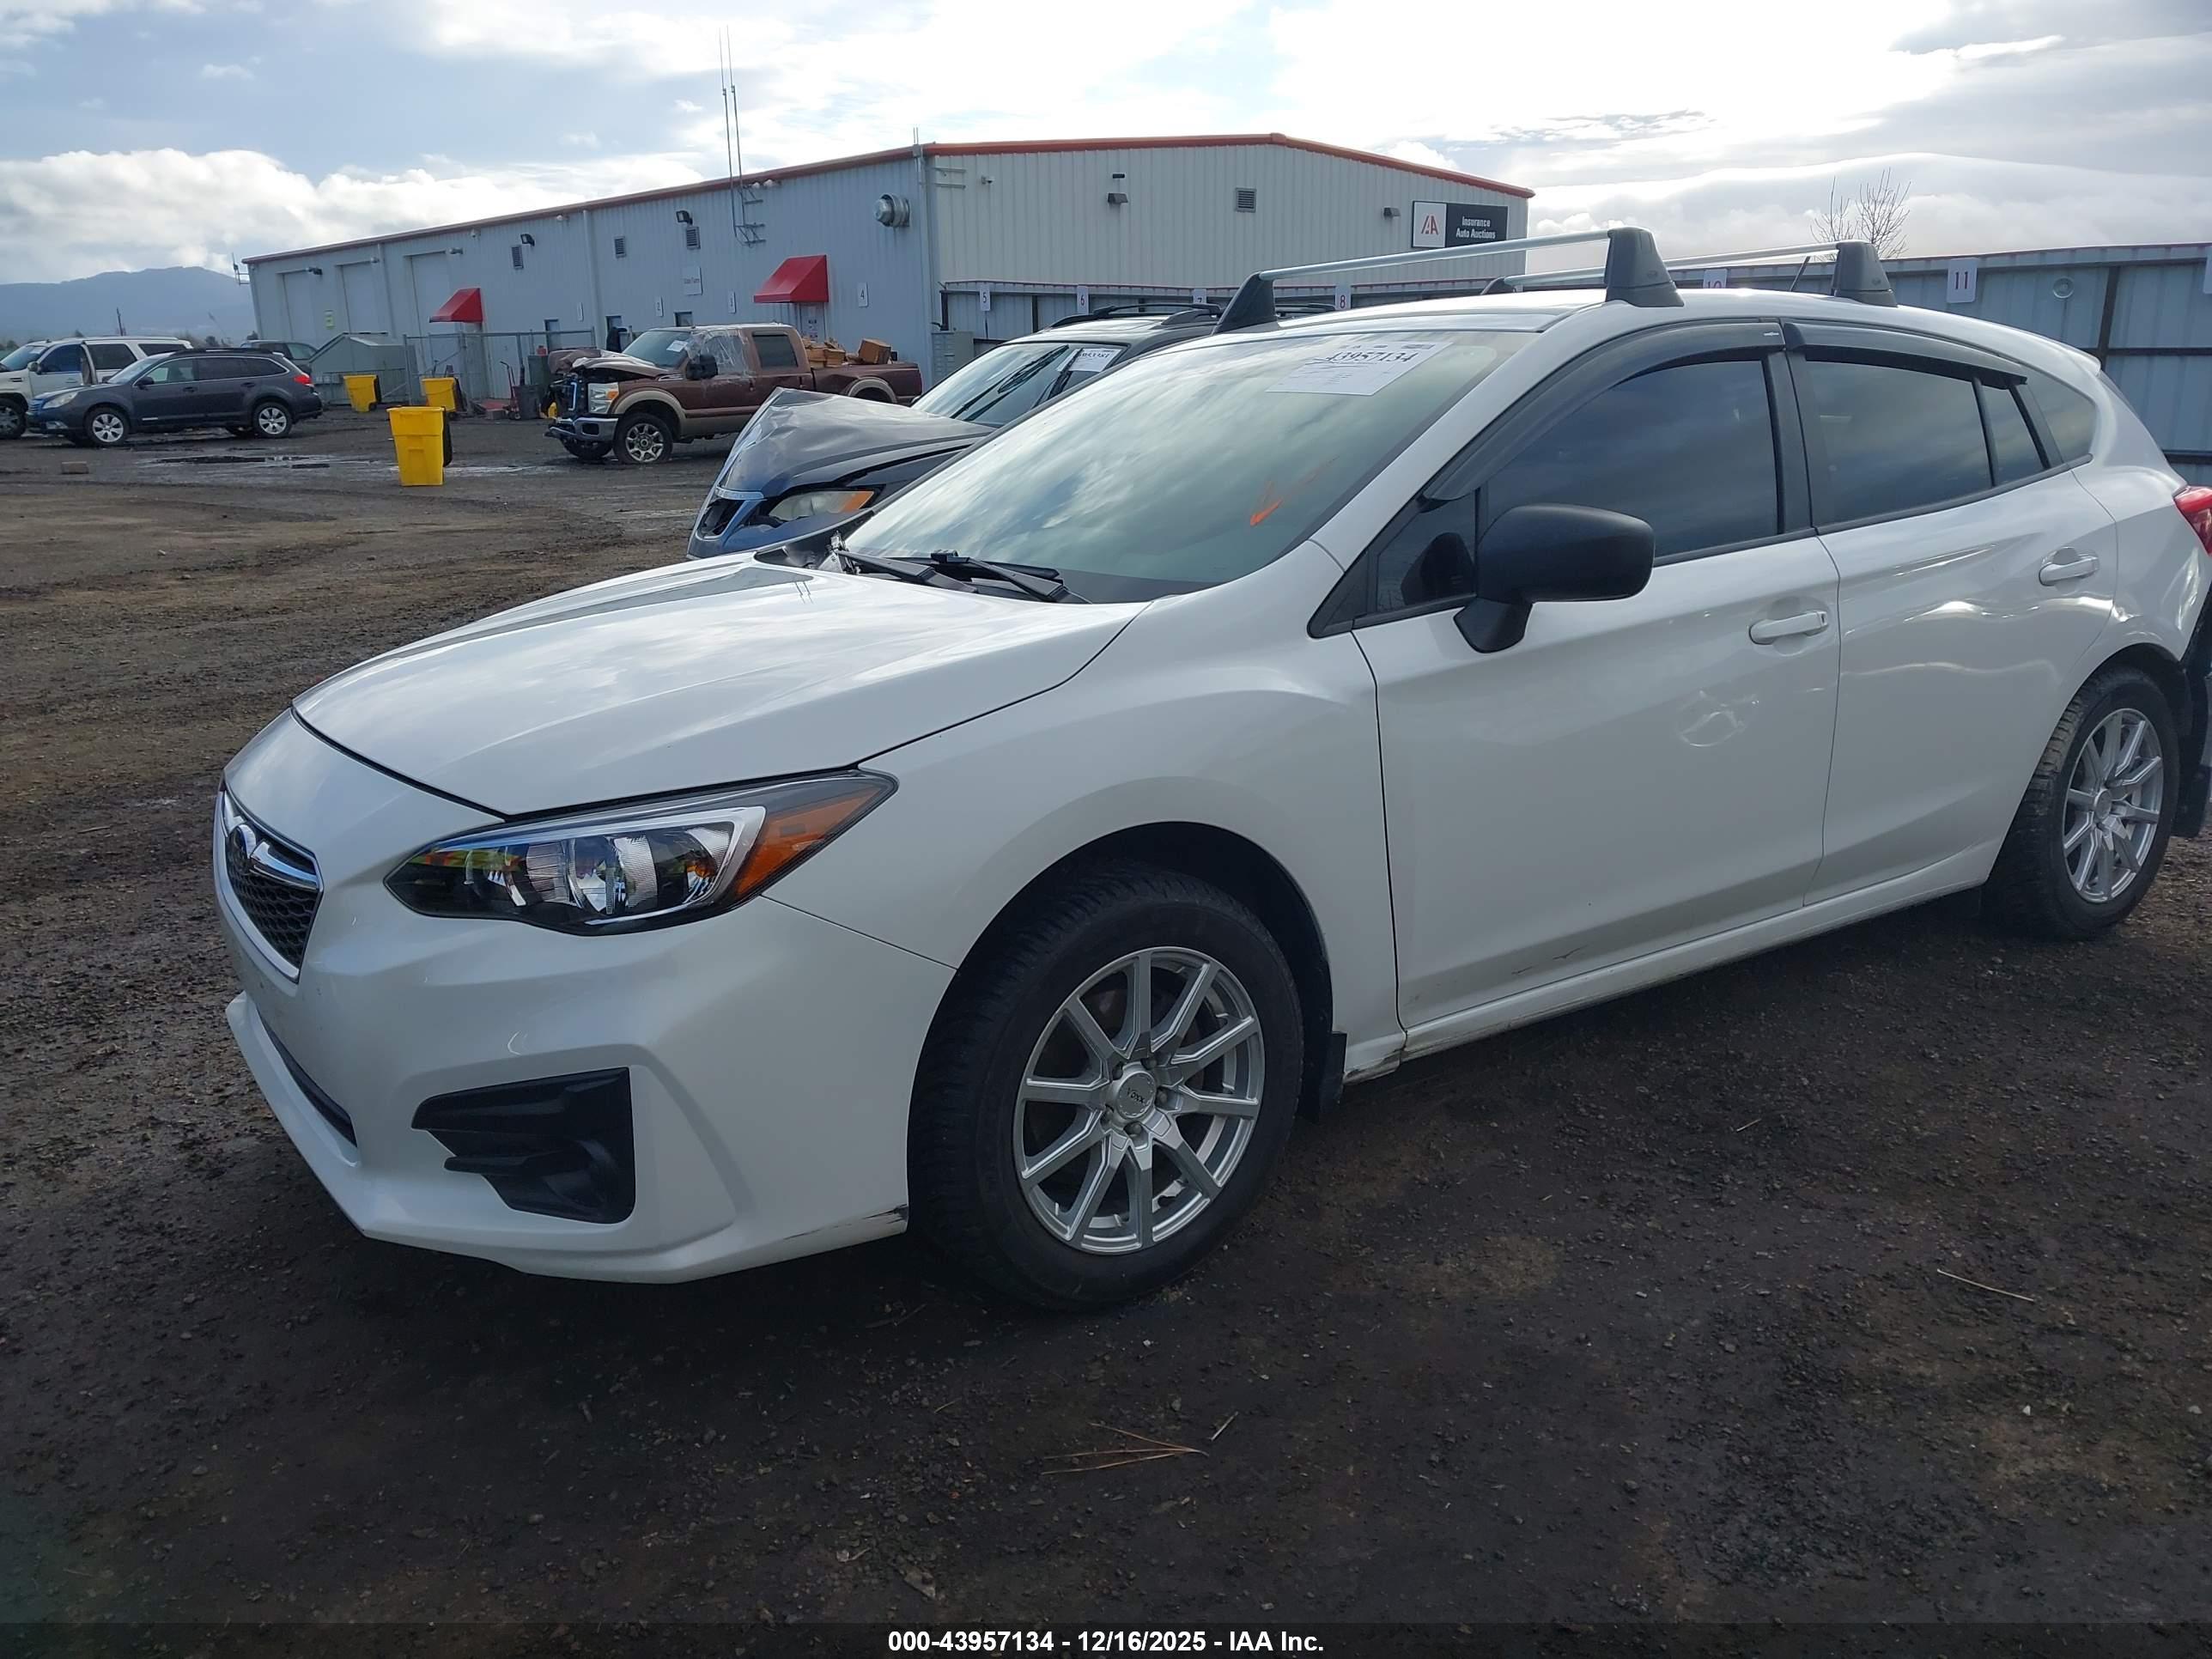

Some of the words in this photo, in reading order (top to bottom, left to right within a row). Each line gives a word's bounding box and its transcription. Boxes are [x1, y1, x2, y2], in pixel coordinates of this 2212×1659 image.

[1462, 216, 1491, 228] Insurance
[1455, 228, 1470, 238] Auto
[1470, 228, 1496, 240] Auctions
[1955, 271, 1968, 289] 11
[1340, 295, 1346, 309] 8
[1326, 351, 1419, 362] 43957134
